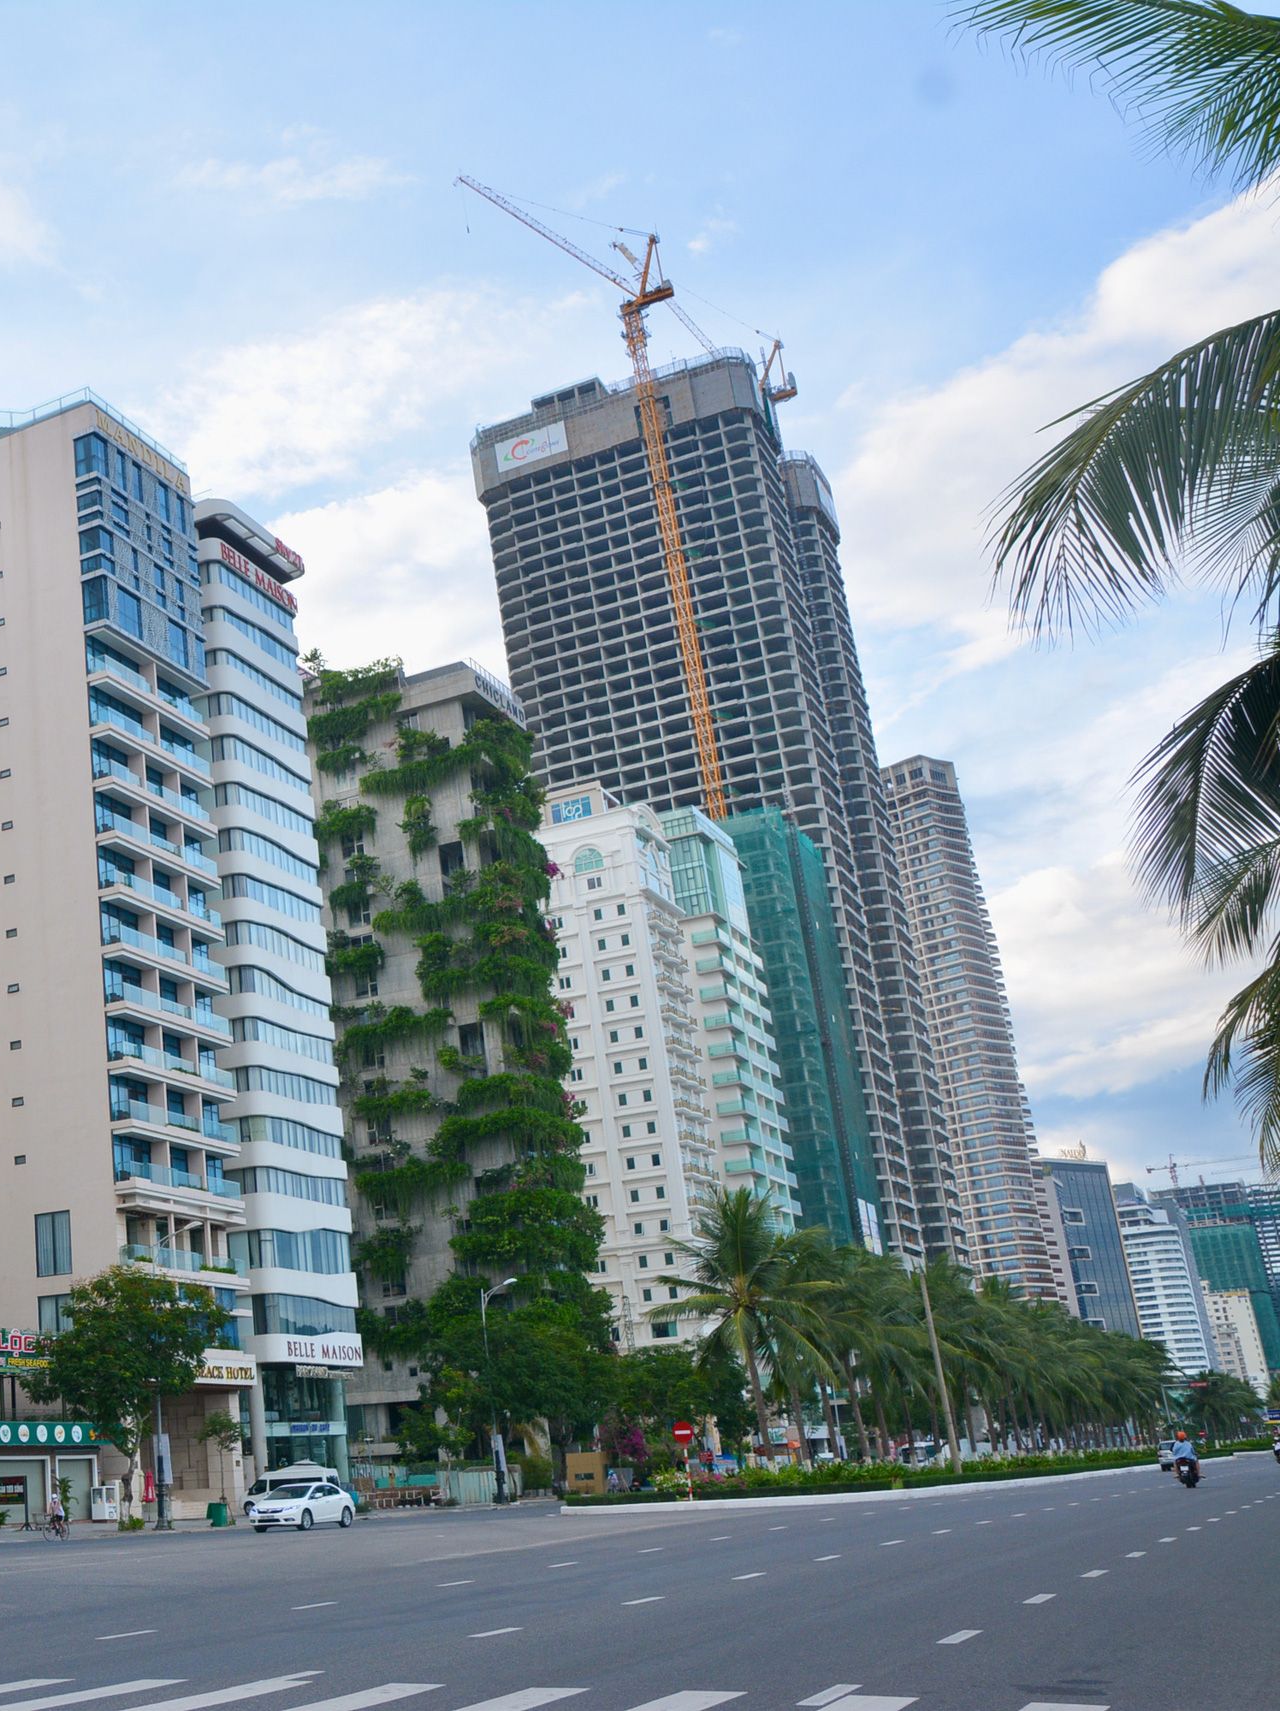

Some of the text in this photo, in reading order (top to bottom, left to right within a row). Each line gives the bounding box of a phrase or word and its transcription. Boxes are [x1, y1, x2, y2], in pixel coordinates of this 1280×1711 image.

[96, 410, 188, 495] MANDILA
[220, 542, 298, 614] BELLE MAISON
[474, 675, 525, 723] CHICLAND
[26, 1359, 49, 1369] SEAFOO
[287, 1341, 362, 1361] BELLE MAISON
[226, 1366, 255, 1380] HOTEL
